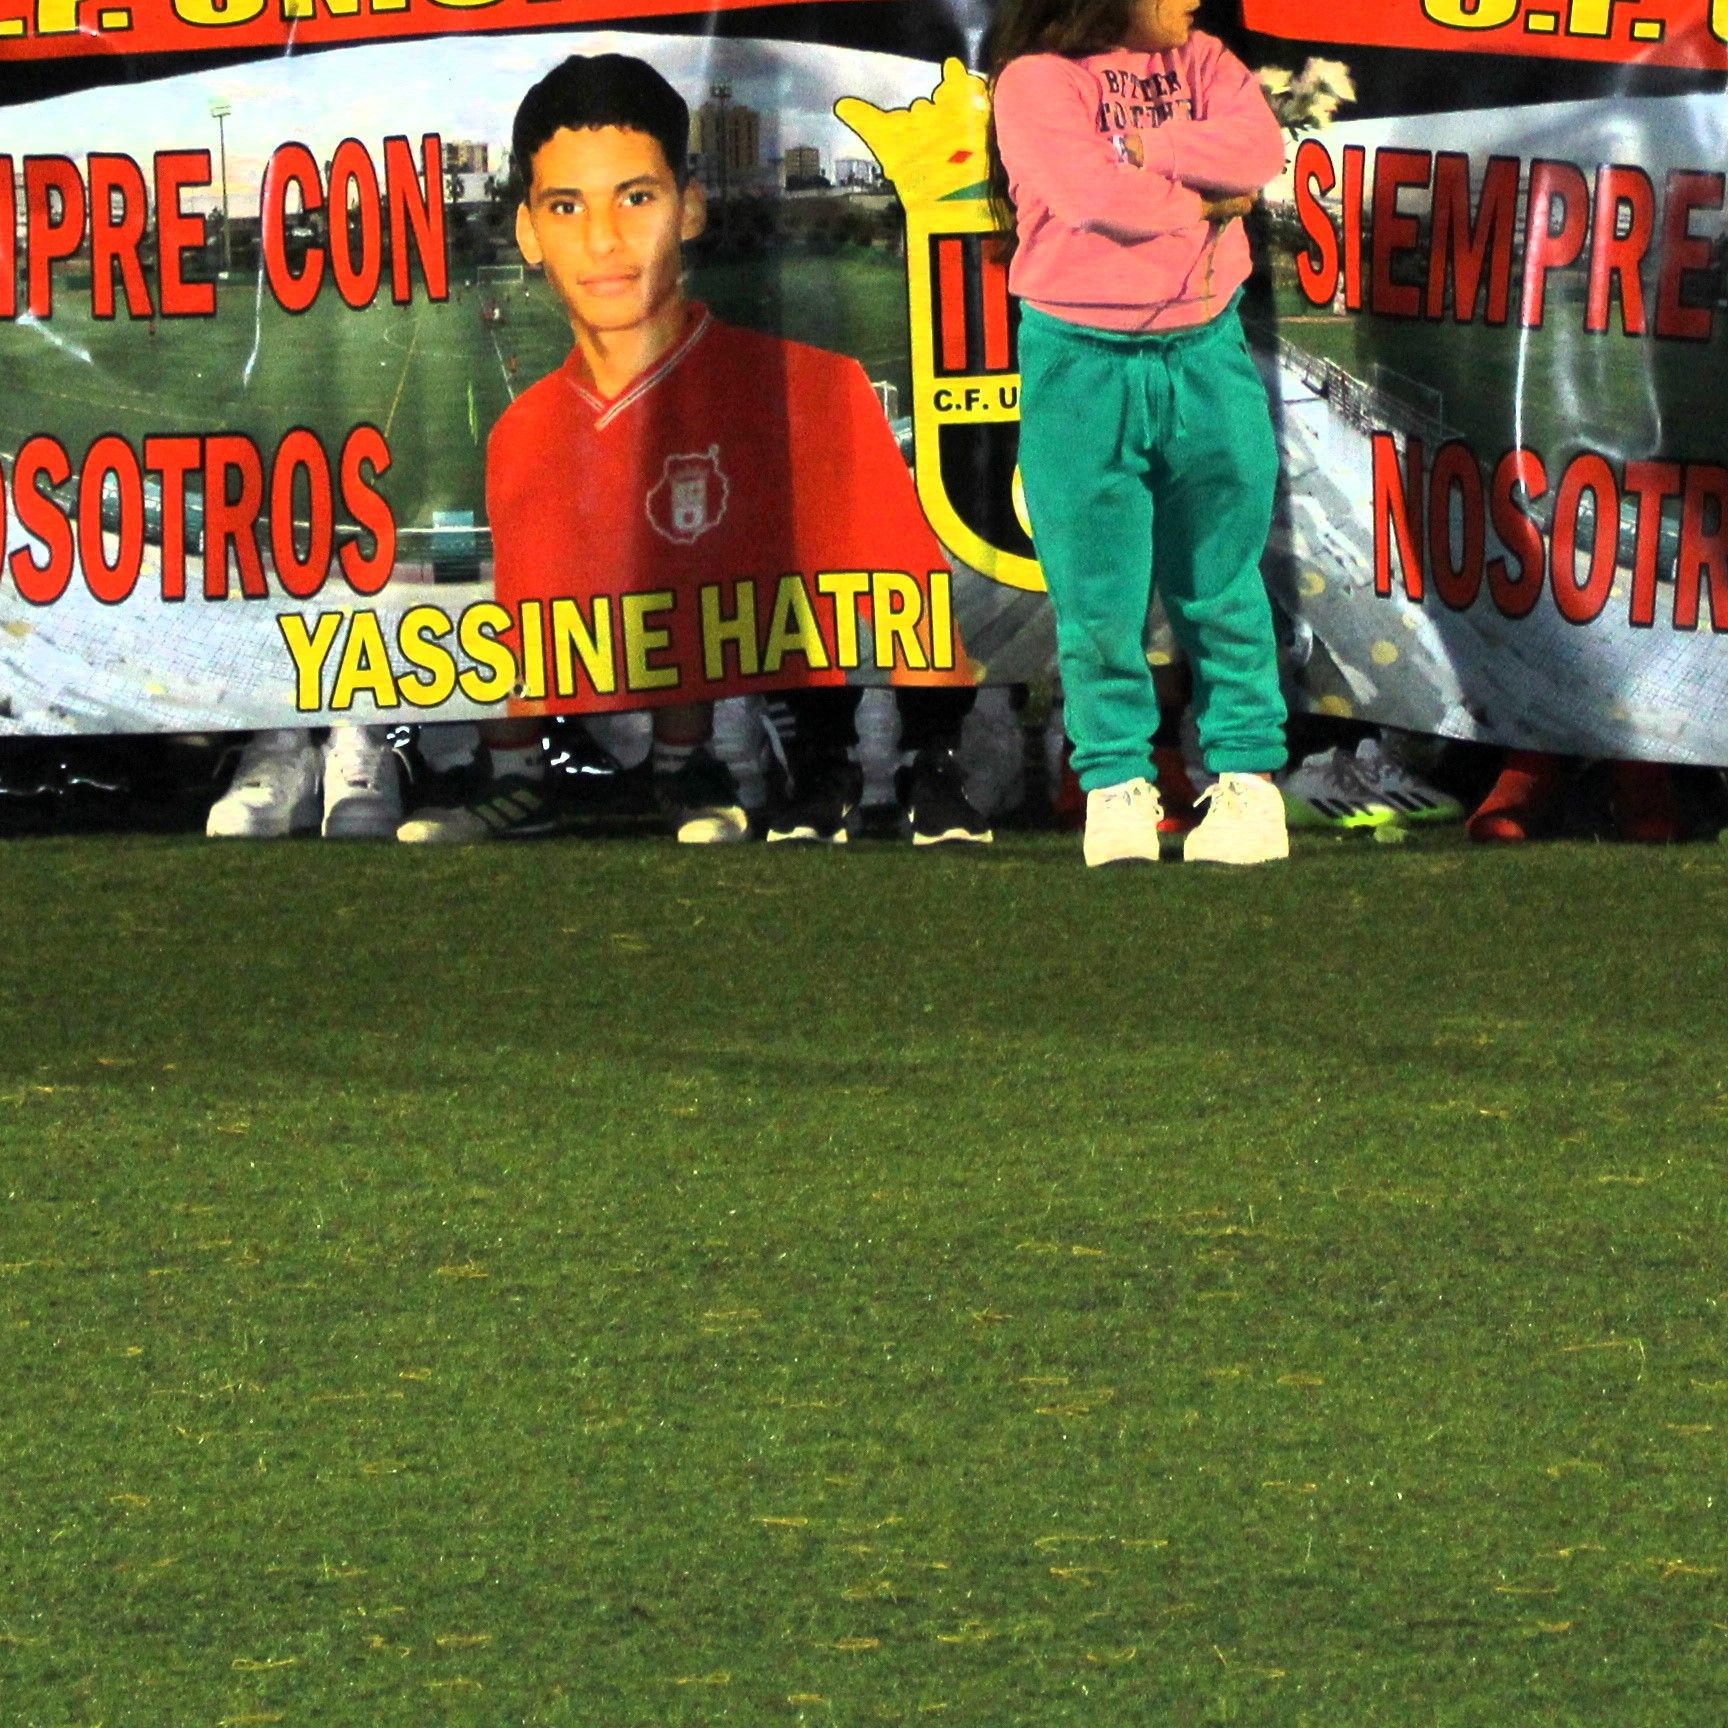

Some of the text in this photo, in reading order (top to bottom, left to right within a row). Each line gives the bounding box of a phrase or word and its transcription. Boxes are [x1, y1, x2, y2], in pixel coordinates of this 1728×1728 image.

[262, 132, 450, 314] CON
[1293, 138, 1725, 342] SIEMPRE
[933, 389, 989, 412] C.F.
[280, 567, 956, 712] YASSINE HATRI
